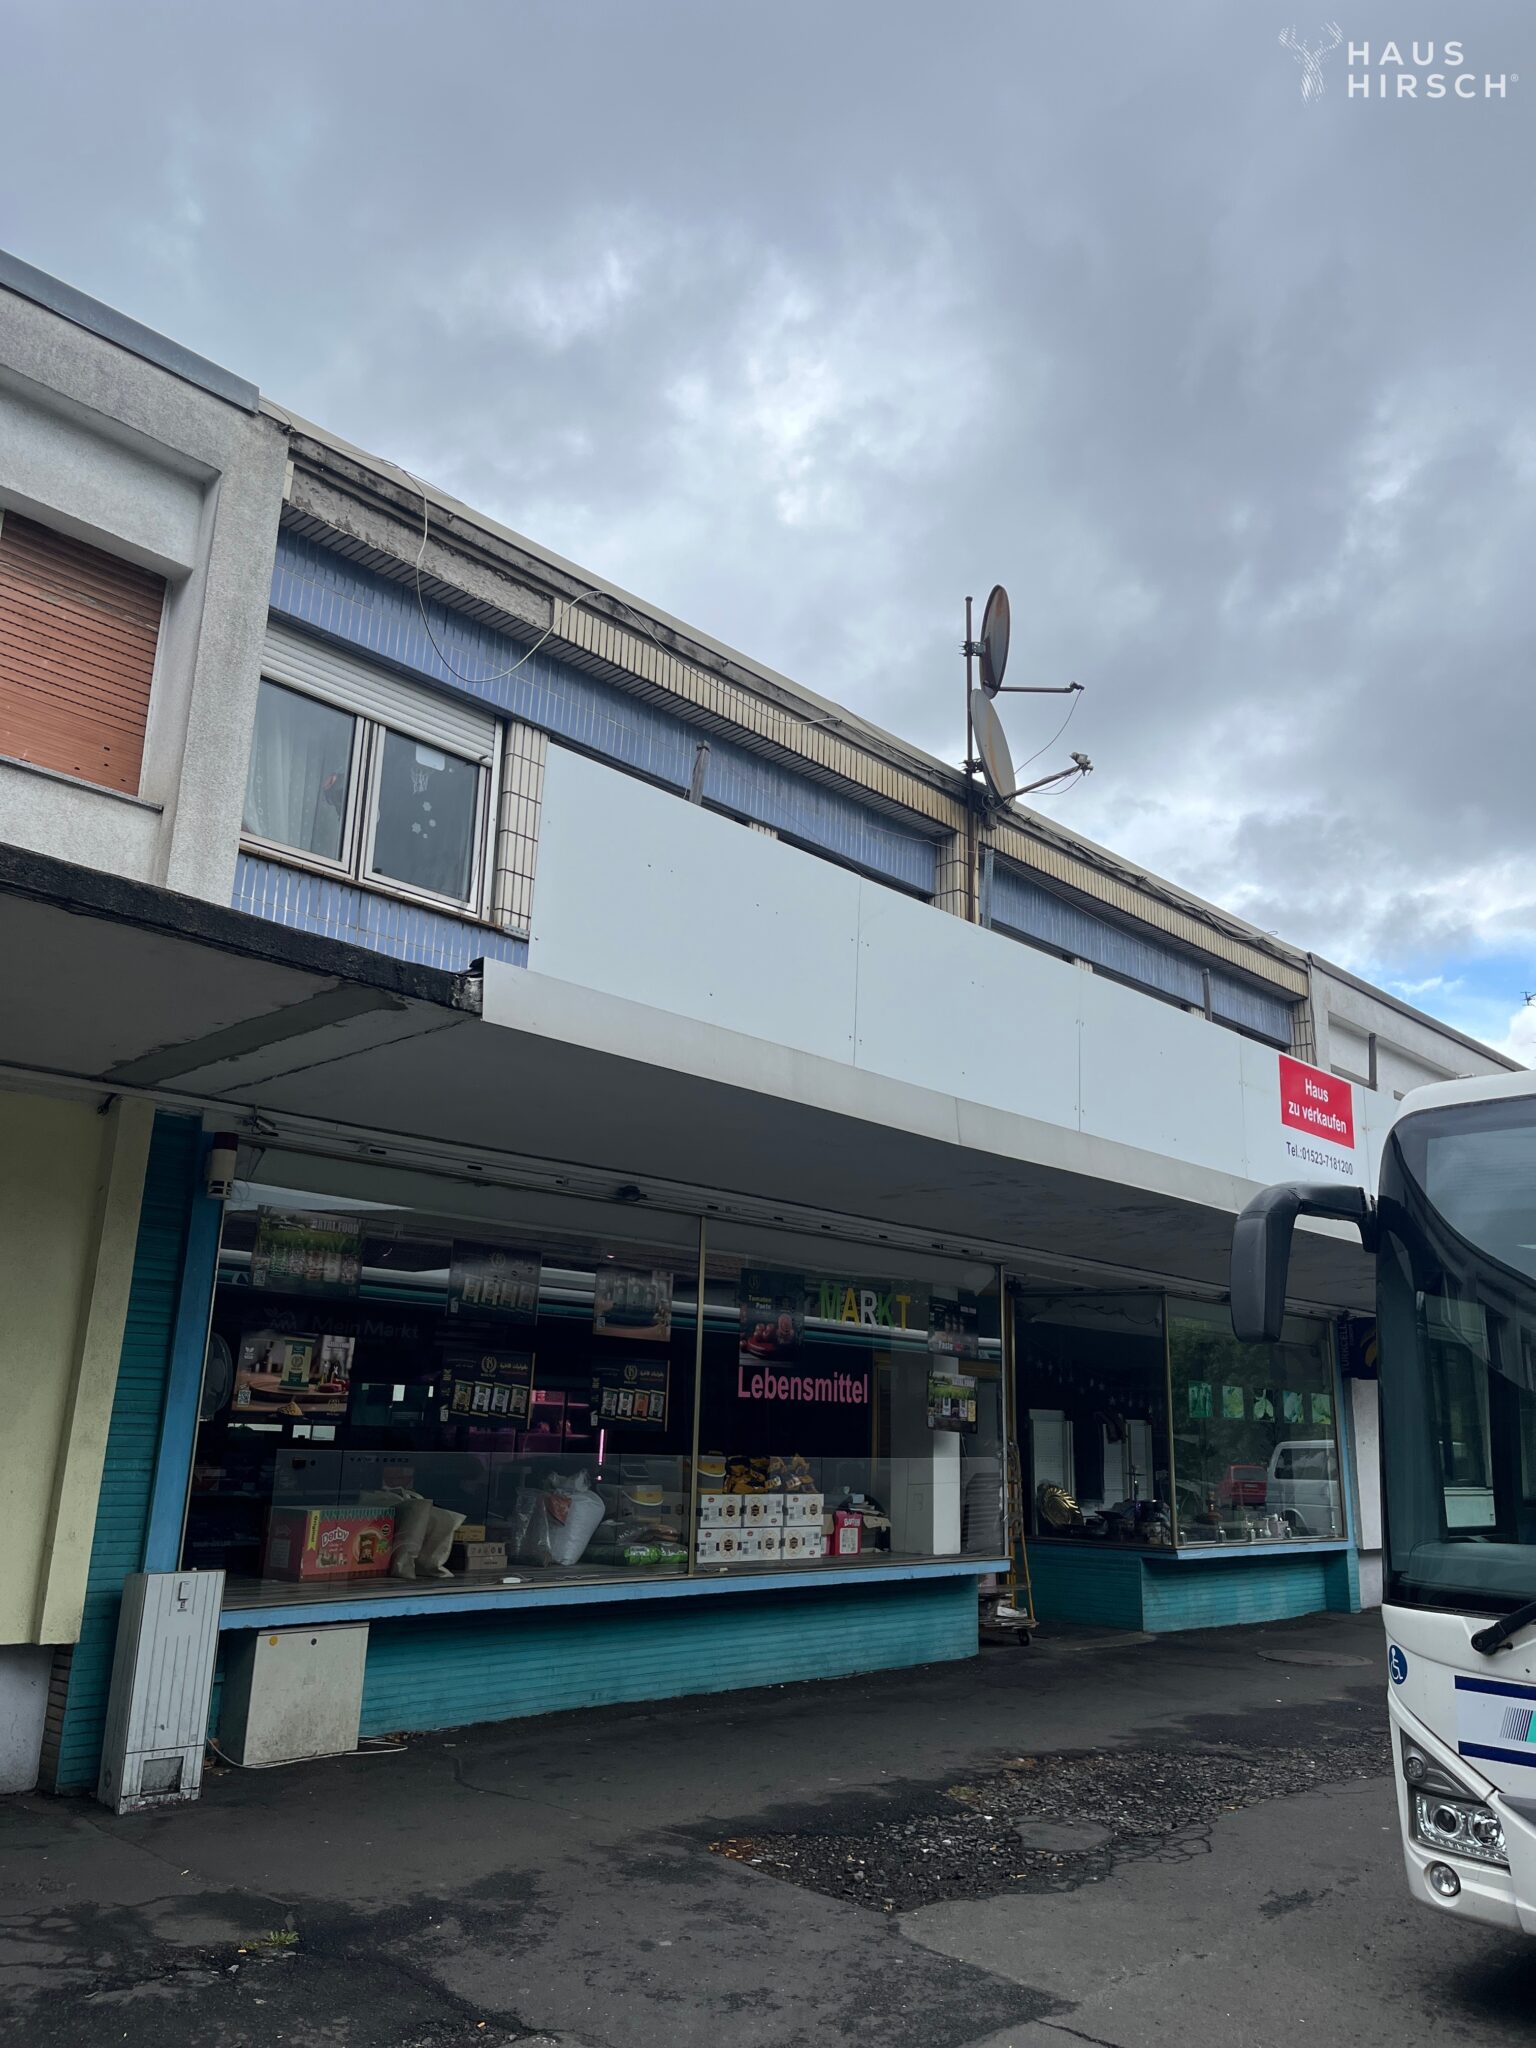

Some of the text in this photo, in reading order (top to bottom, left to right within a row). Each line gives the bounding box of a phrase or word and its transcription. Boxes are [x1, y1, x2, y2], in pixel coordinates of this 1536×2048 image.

[1304, 1078, 1329, 1103] Haus
[1288, 1100, 1347, 1134] zu verkaufen
[819, 1281, 911, 1329] MARKT
[363, 1319, 419, 1339] Markt
[738, 1366, 868, 1404] Lebensmittel
[320, 1526, 350, 1548] Derby
